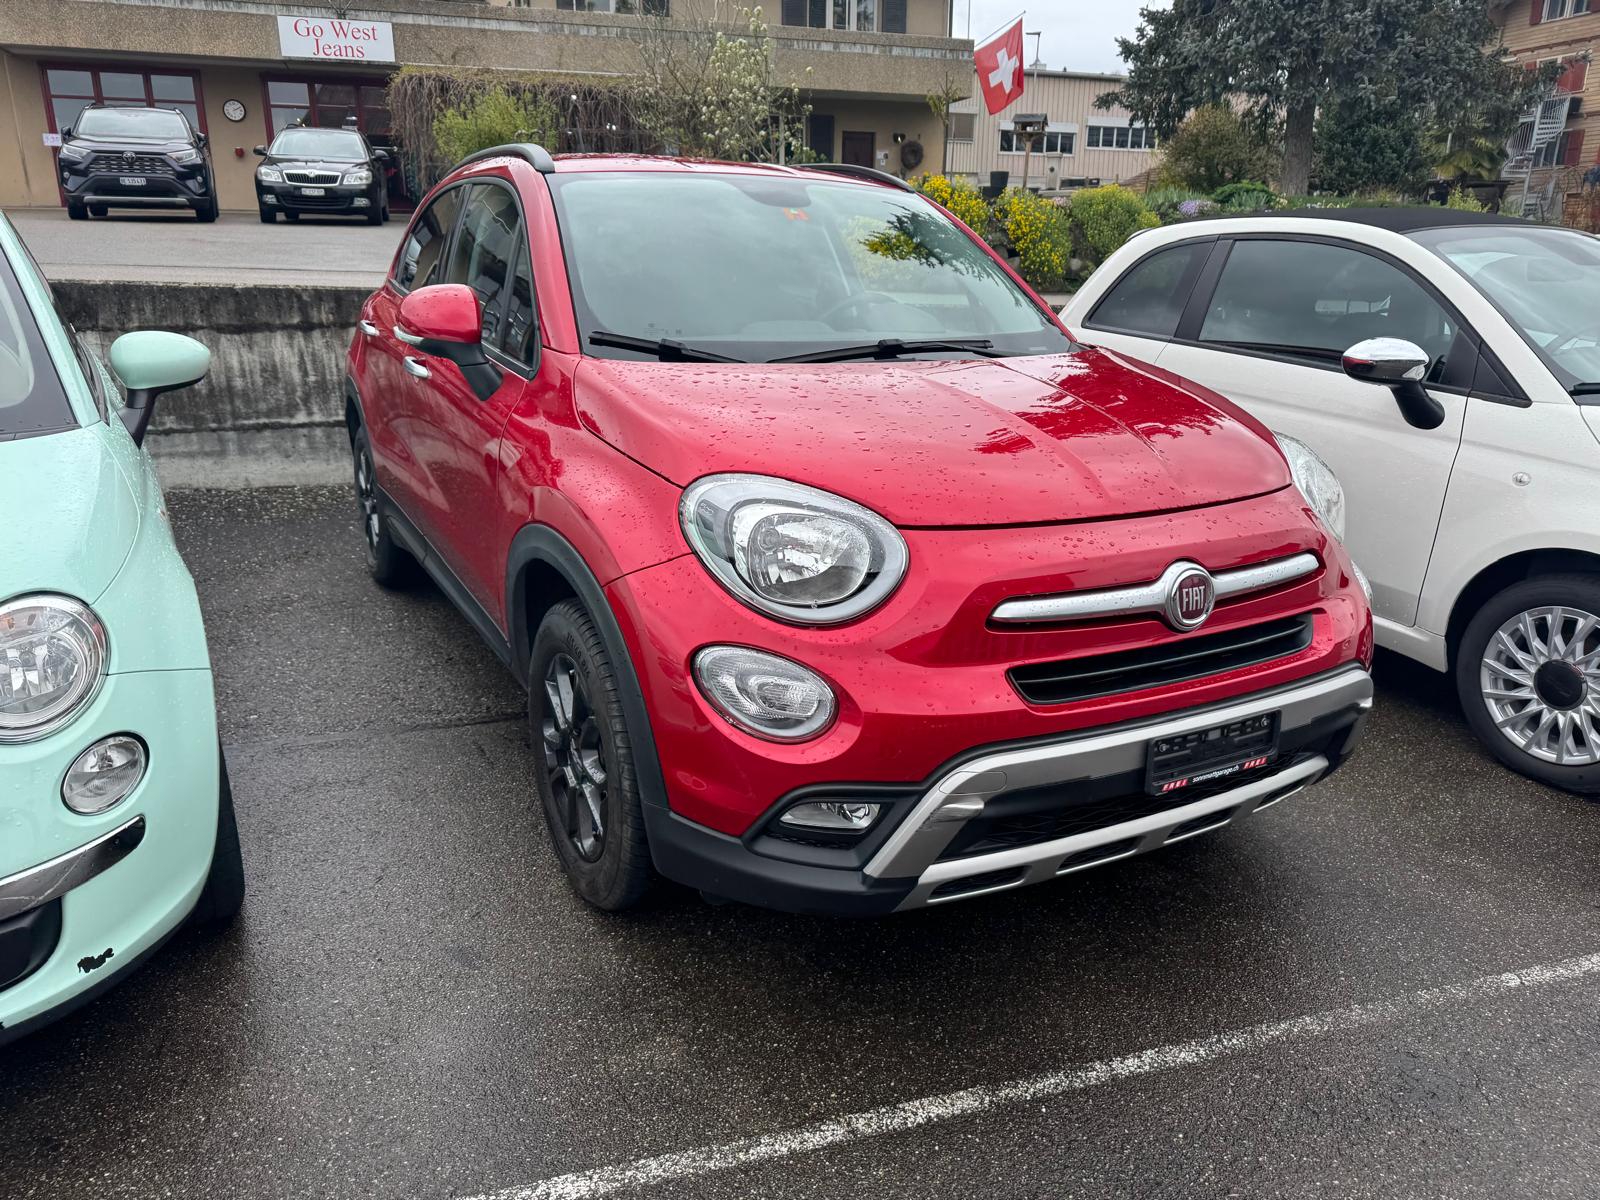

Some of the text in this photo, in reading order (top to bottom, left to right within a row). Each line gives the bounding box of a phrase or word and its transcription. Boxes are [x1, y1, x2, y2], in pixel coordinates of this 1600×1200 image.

[293, 18, 378, 41] Go West
[313, 38, 365, 58] Jeans
[1182, 585, 1205, 612] FIAT
